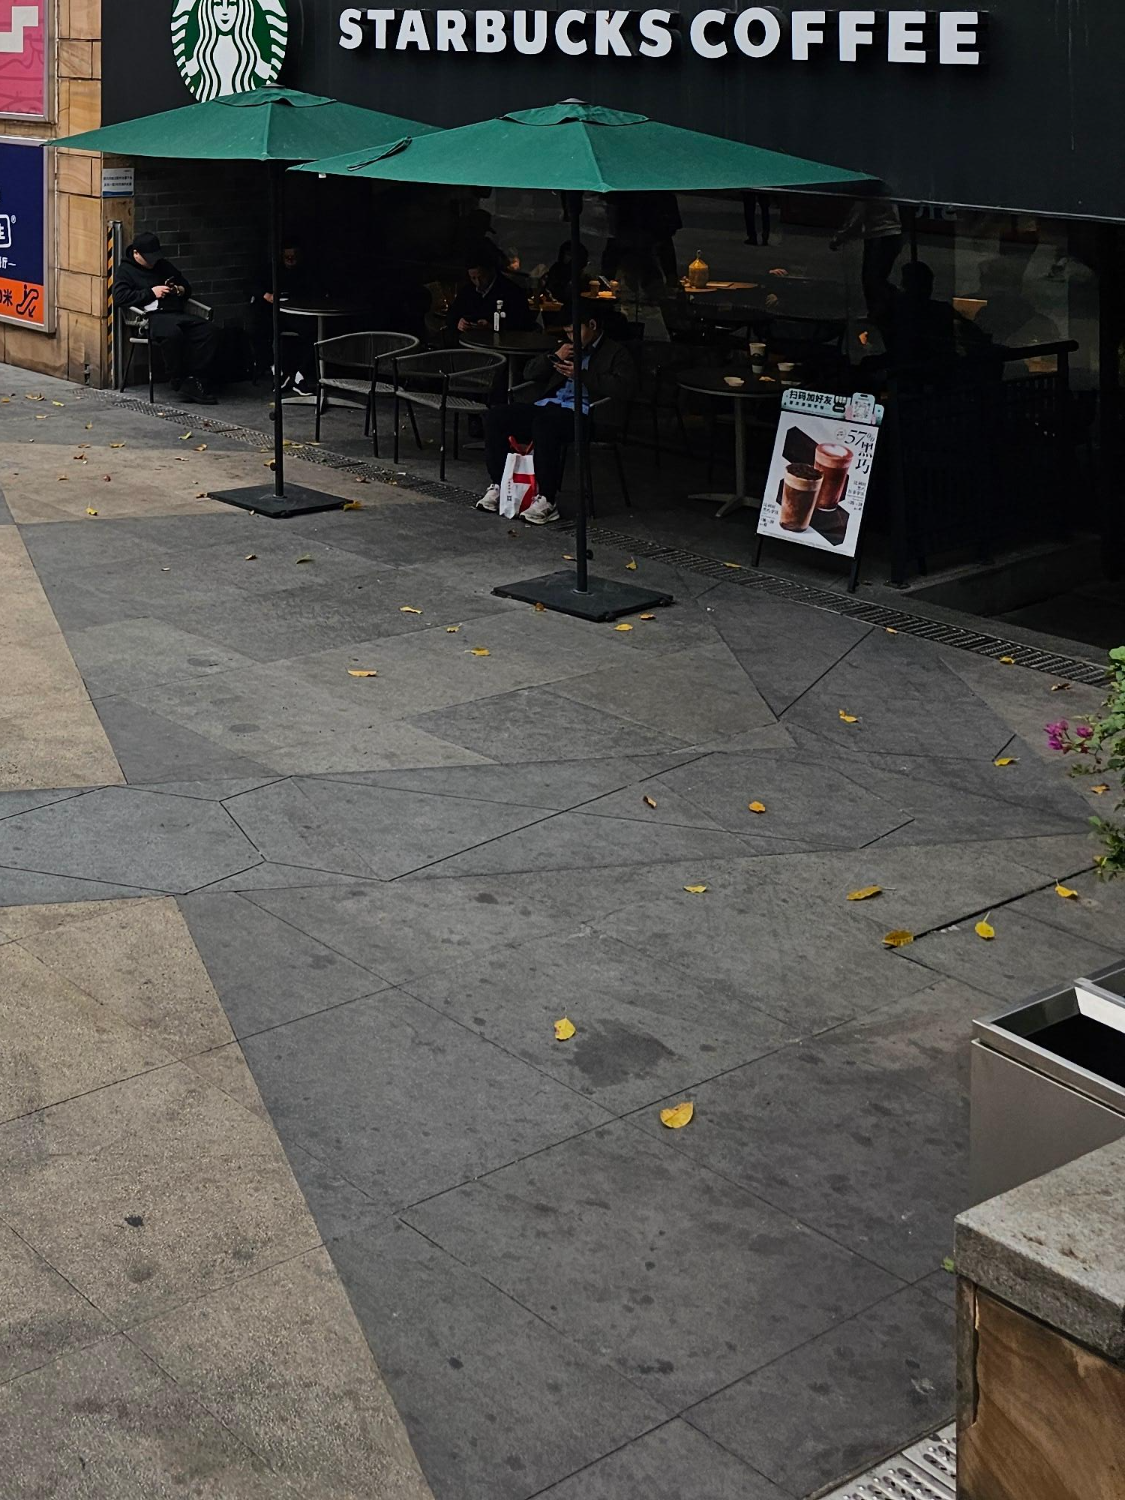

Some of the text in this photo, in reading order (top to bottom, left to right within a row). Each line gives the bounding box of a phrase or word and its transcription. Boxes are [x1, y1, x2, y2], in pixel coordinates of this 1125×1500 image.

[338, 7, 979, 64] STARBUCKS COFFEE
[789, 389, 832, 405] 扫码加好友
